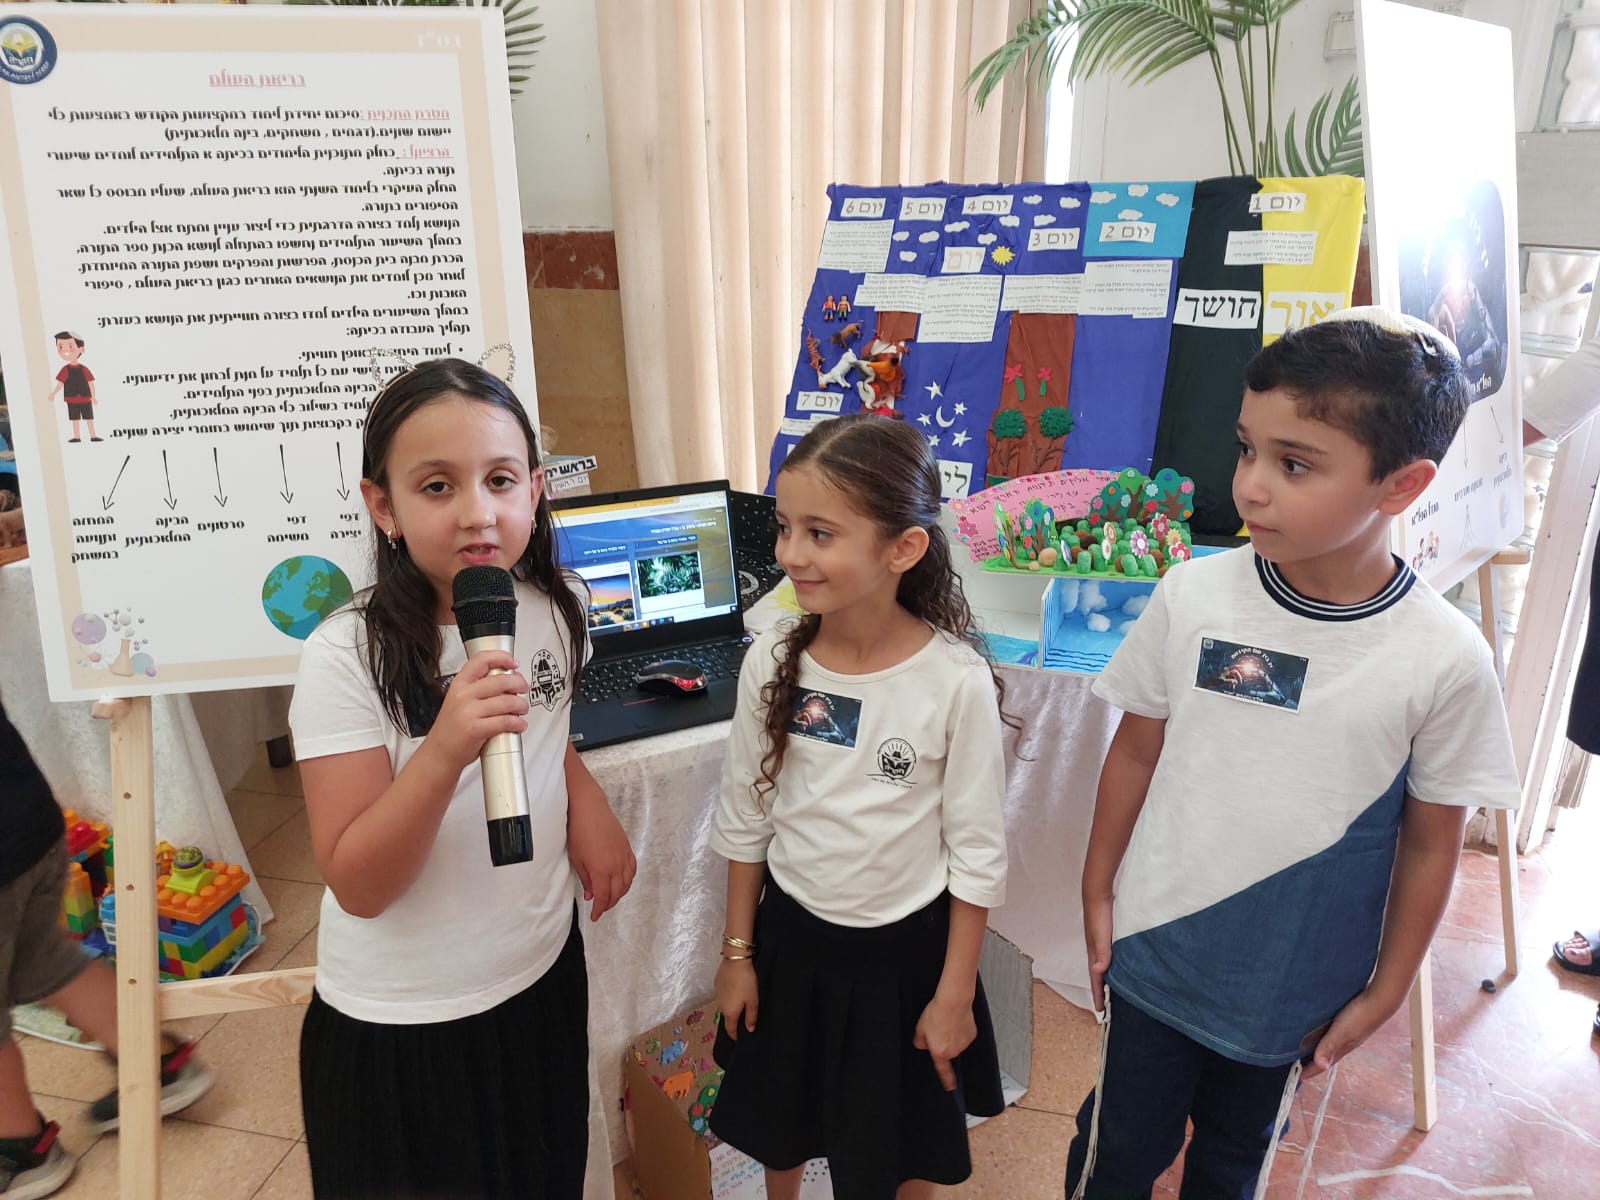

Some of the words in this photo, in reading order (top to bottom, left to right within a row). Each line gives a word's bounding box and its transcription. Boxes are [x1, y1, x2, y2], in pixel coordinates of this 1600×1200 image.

[208, 69, 255, 86] העולם
[260, 73, 305, 87] בריאת
[845, 202, 854, 214] 6
[858, 201, 885, 213] יום
[904, 202, 914, 215] 5
[917, 200, 944, 214] יום
[966, 199, 977, 212] 4
[981, 198, 1009, 212] יום
[1252, 195, 1262, 210] 1
[1269, 195, 1303, 211] יום
[1031, 233, 1042, 246] 3
[1047, 231, 1075, 246] יום
[1104, 226, 1116, 239] 2
[1121, 225, 1151, 241] יום
[946, 250, 984, 271] יום
[1183, 294, 1258, 323] חושך
[1270, 299, 1336, 328] אור
[377, 347, 419, 358] היחיה
[422, 342, 452, 356] לימוד
[801, 393, 811, 407] 7
[814, 394, 841, 409] יום
[155, 515, 189, 528] הבינה
[286, 514, 307, 524] דפי
[338, 512, 360, 522] דפי
